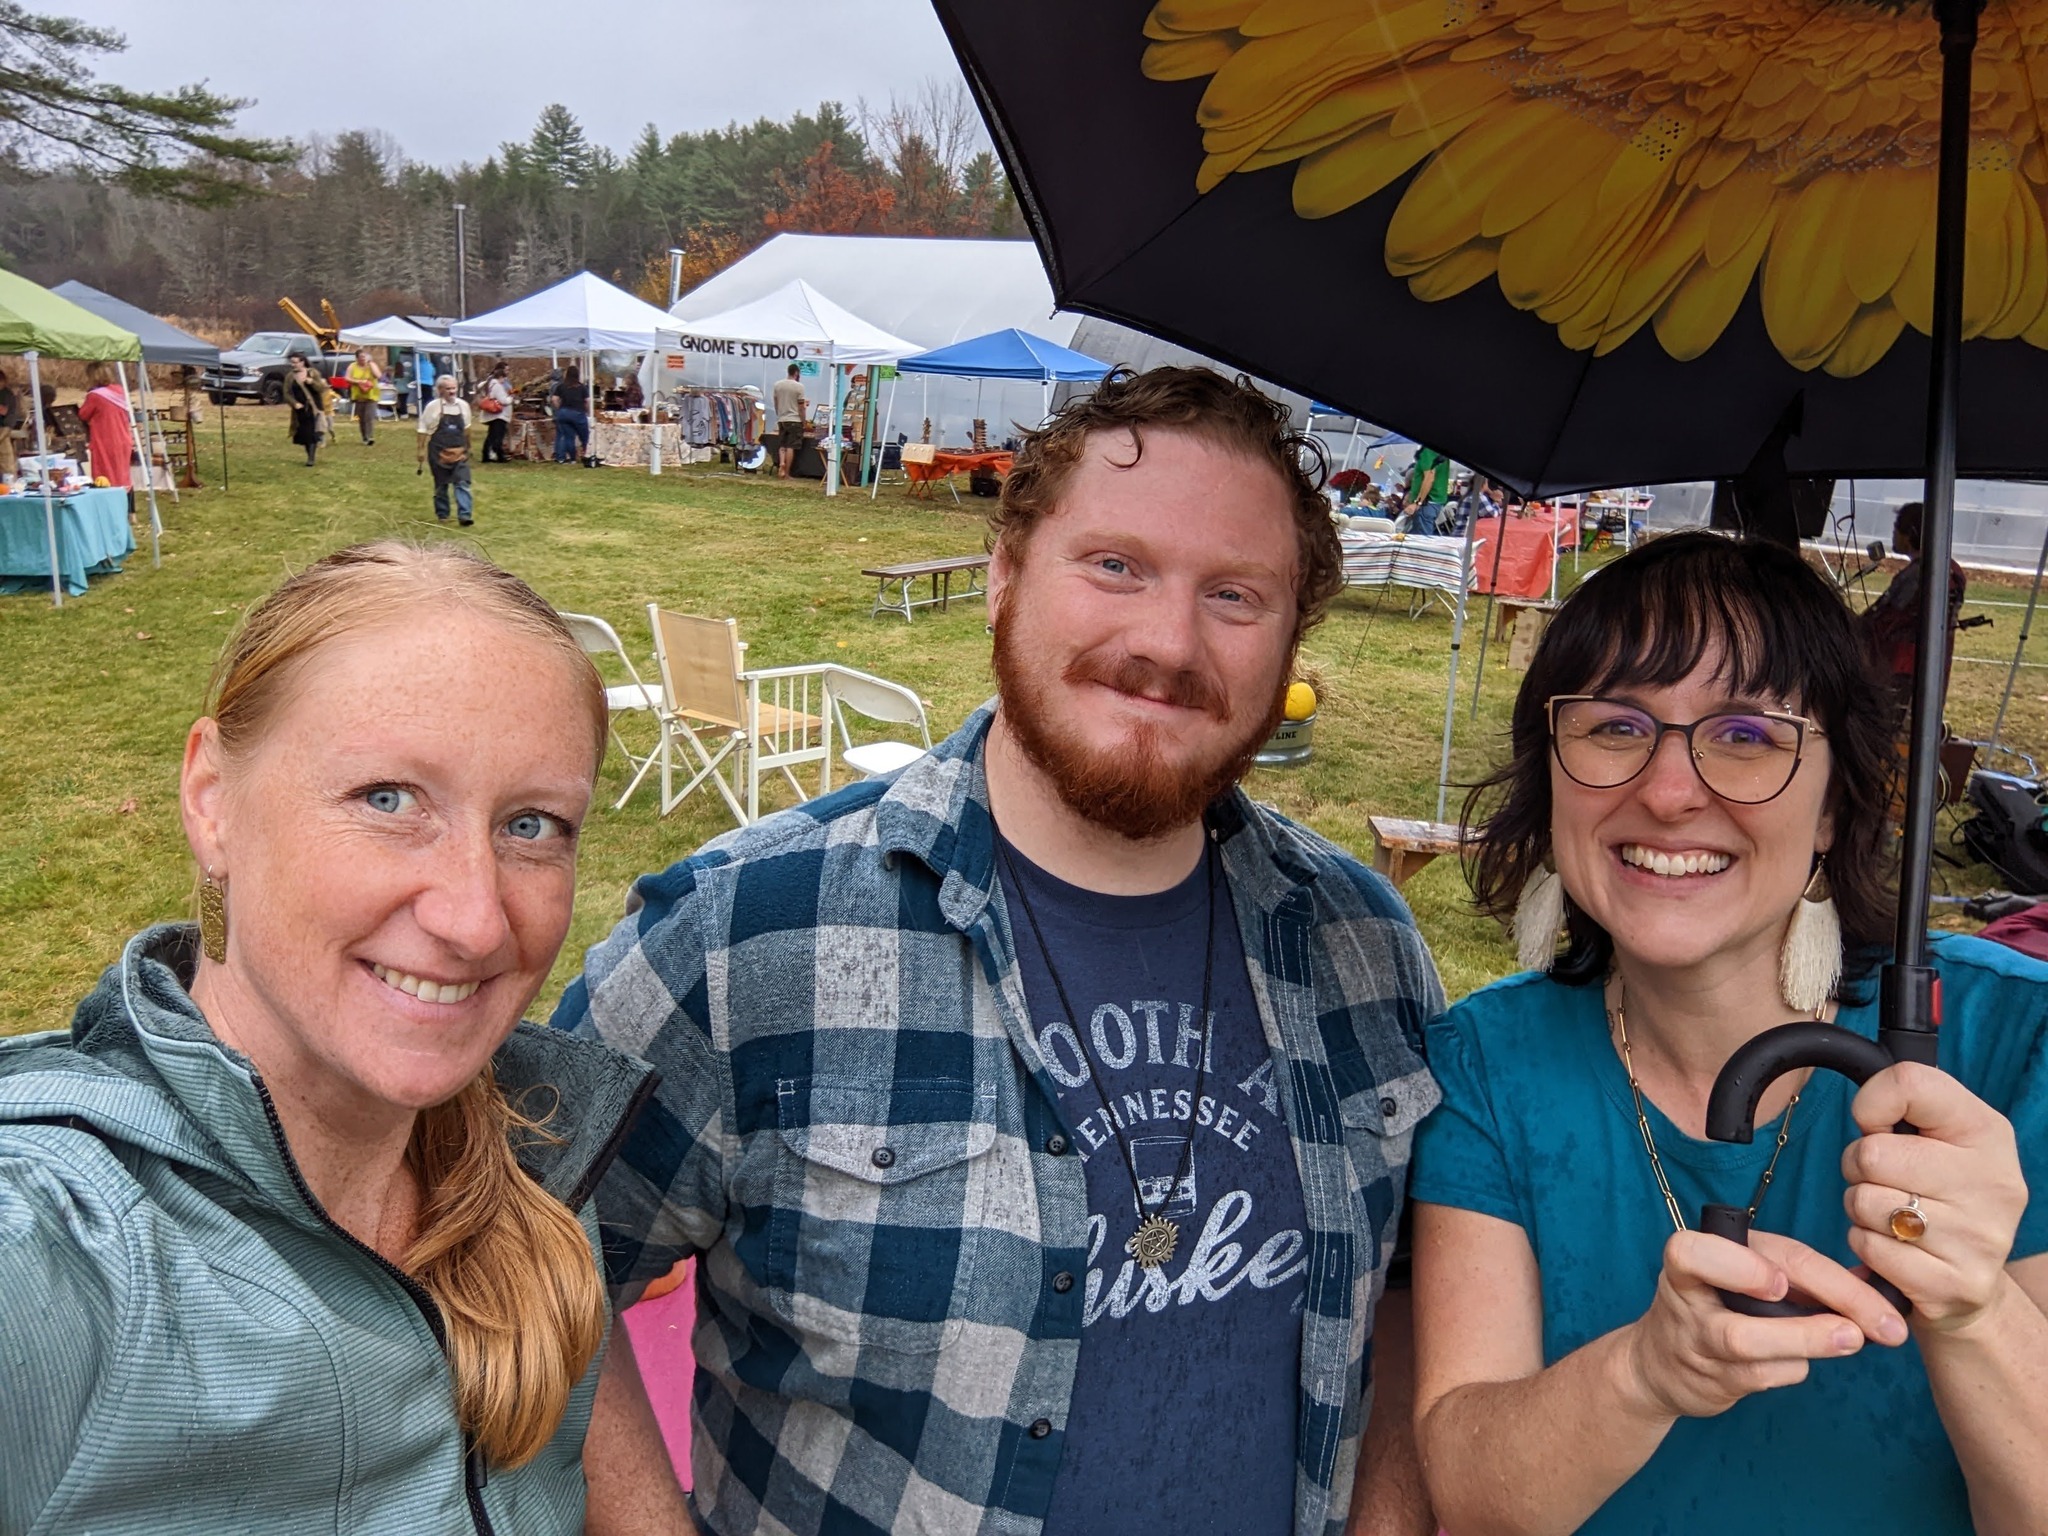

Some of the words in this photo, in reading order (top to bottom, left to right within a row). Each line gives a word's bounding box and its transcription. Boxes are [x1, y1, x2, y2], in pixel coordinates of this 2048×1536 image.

[680, 335, 736, 355] GNOME
[740, 342, 799, 360] STUDIO
[1275, 731, 1297, 740] LINE
[1039, 1000, 1216, 1099] OOTH
[1075, 1088, 1261, 1163] ENNESSEE
